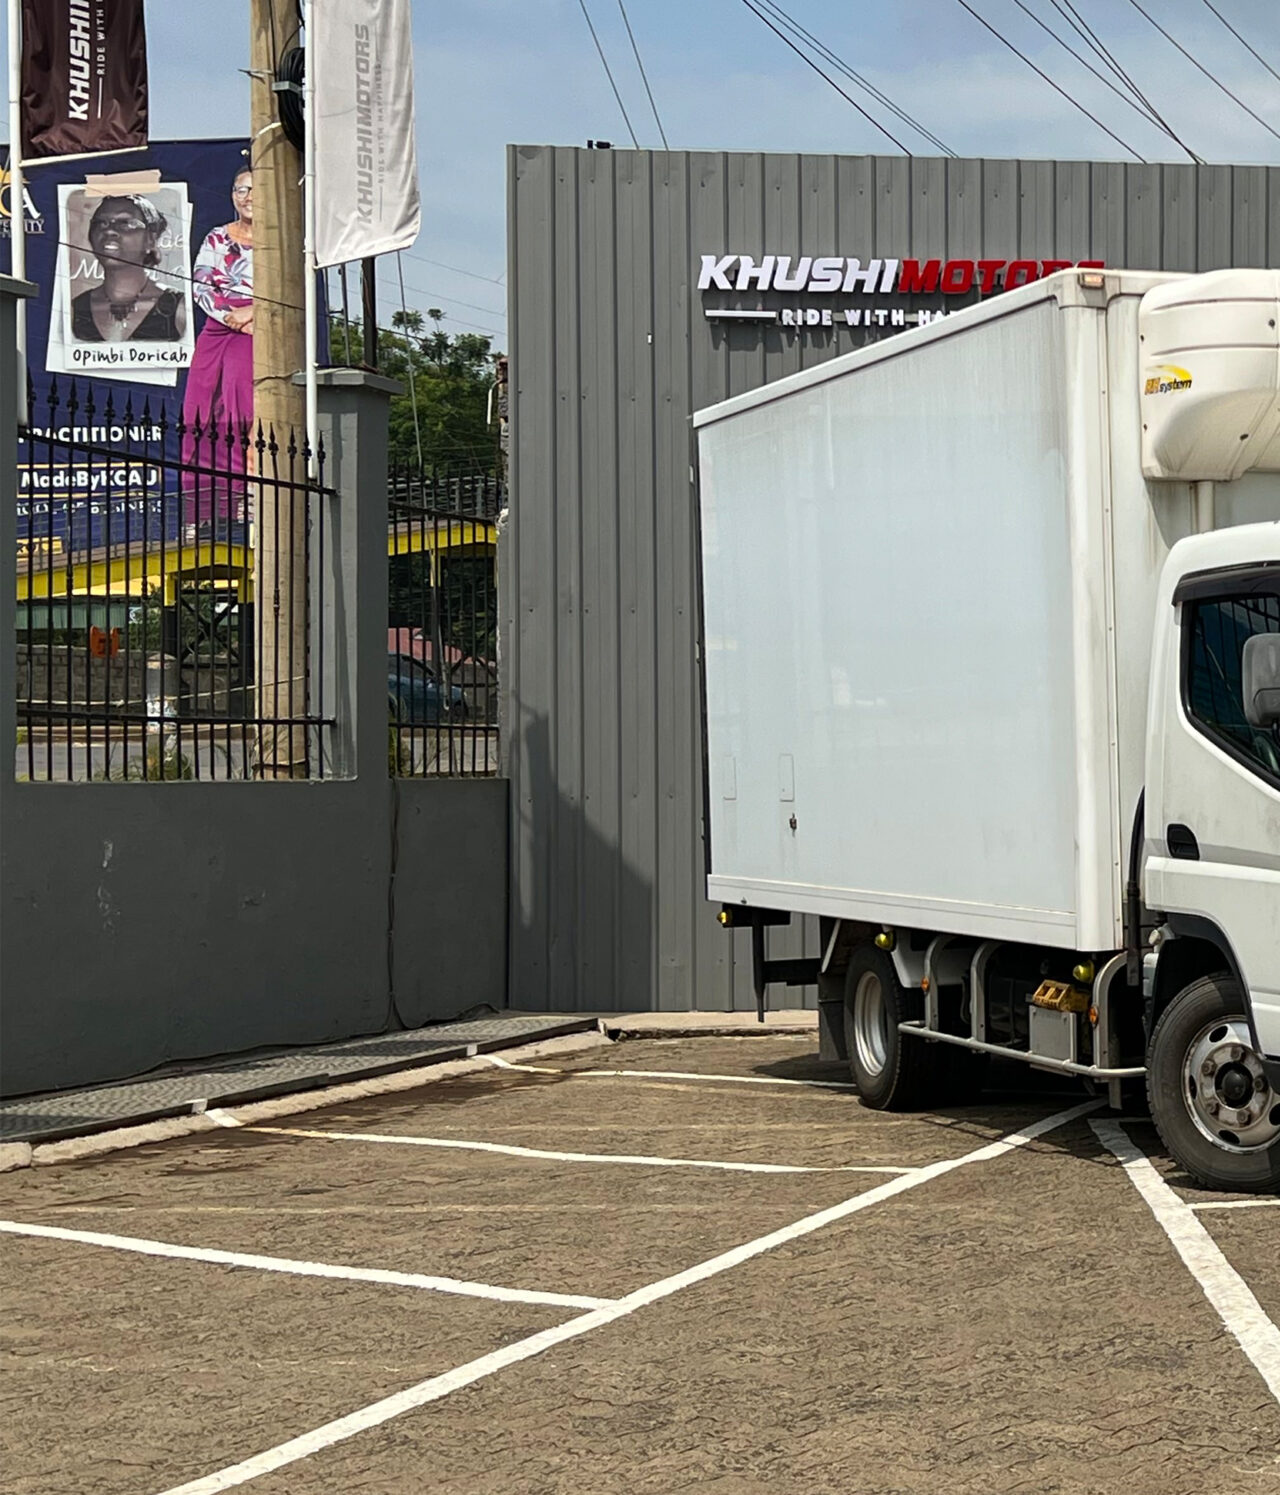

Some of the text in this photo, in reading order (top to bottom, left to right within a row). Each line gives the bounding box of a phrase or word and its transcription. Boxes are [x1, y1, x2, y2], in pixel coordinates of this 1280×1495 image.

[96, 9, 106, 41] WITH
[96, 46, 106, 75] RIDE
[355, 23, 373, 224] KHUSHIMOTORS
[697, 255, 1105, 294] KHUSHIMOTO
[781, 309, 833, 326] RIDE
[844, 309, 905, 326] WITH
[129, 347, 188, 363] Doricah
